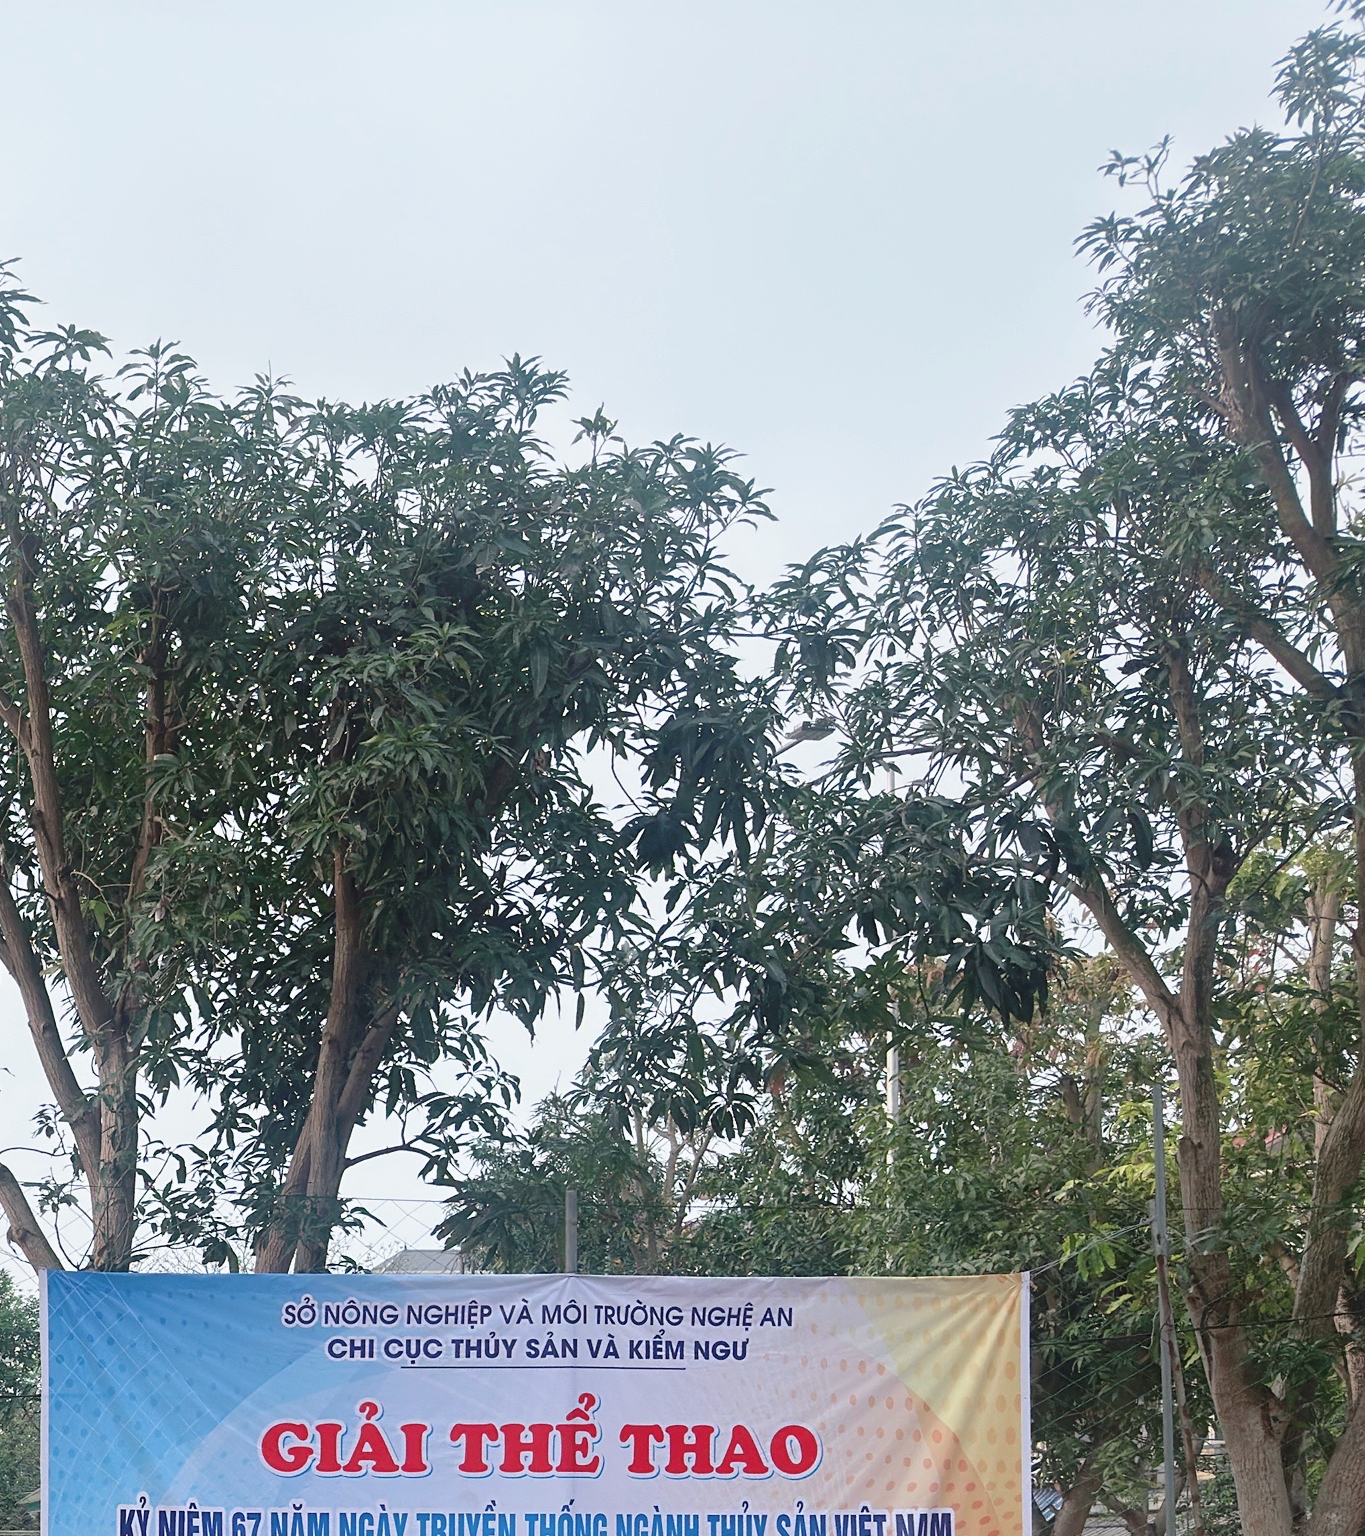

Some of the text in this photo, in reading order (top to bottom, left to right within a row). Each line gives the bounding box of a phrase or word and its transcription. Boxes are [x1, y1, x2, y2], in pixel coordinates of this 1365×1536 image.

[284, 1297, 793, 1331] SỞ NÔNG NGHIỆP VÀ MÔI TRƯỜNG NGHỆ AN
[327, 1329, 750, 1365] CHI CỤC THỦY SẢN VÀ KIỂM NGƯ
[261, 1392, 818, 1475] GIẢI THỂ THAO
